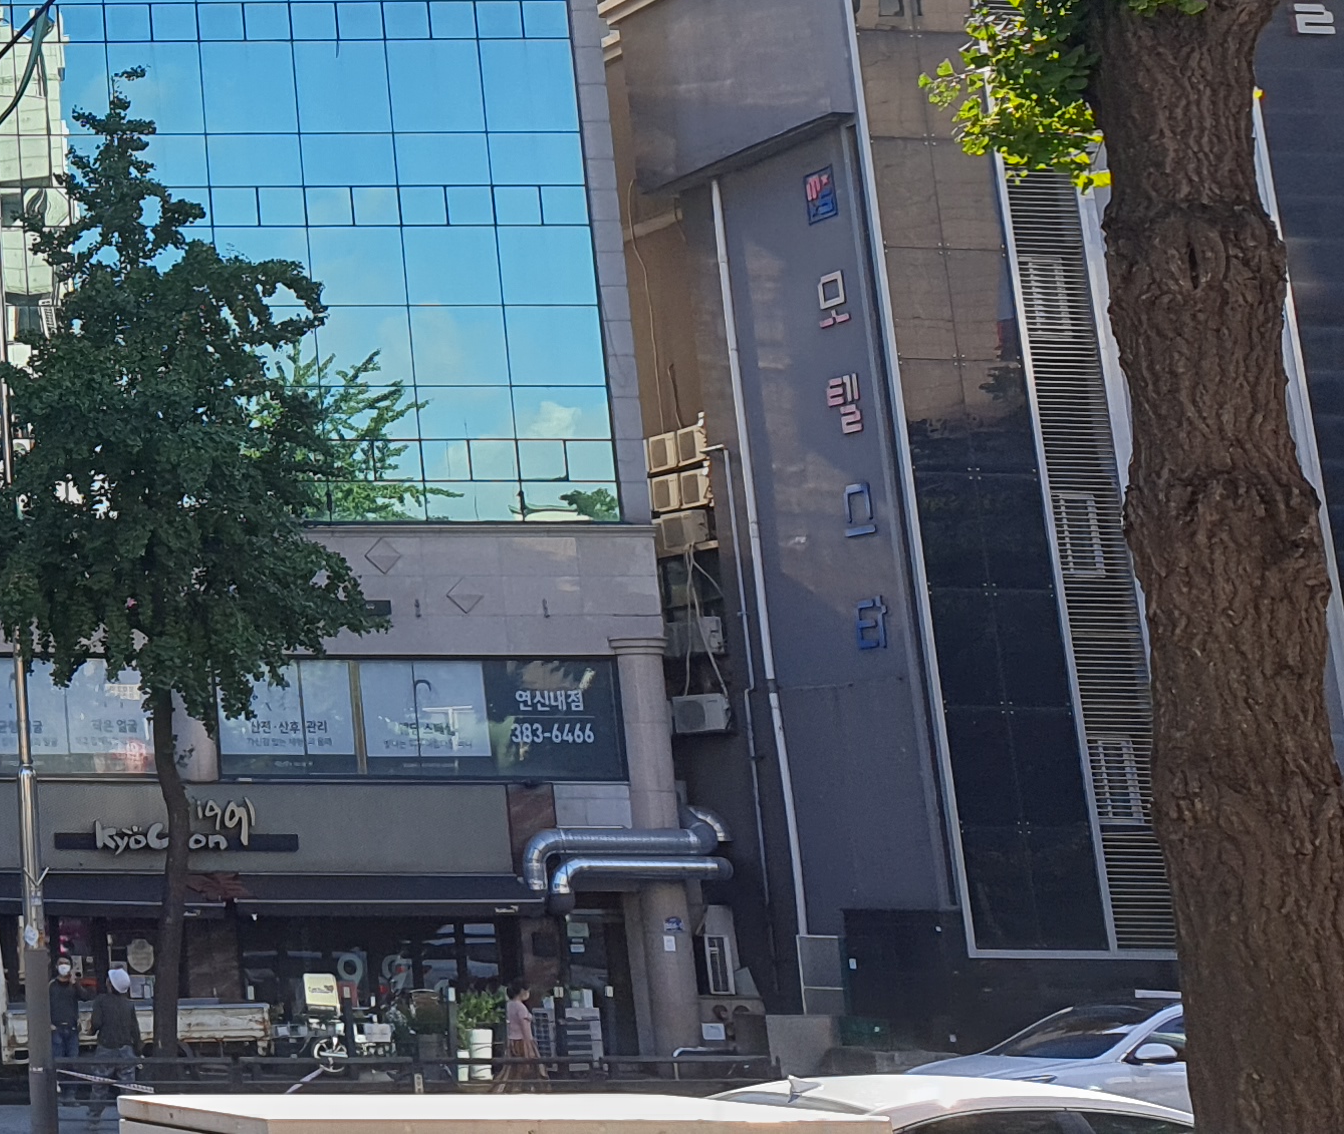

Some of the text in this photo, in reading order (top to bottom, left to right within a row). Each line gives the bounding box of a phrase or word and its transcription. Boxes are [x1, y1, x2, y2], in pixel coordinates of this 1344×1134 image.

[515, 689, 585, 712] 연신내점
[306, 719, 328, 734] 관리
[511, 722, 595, 744] 383-6466
